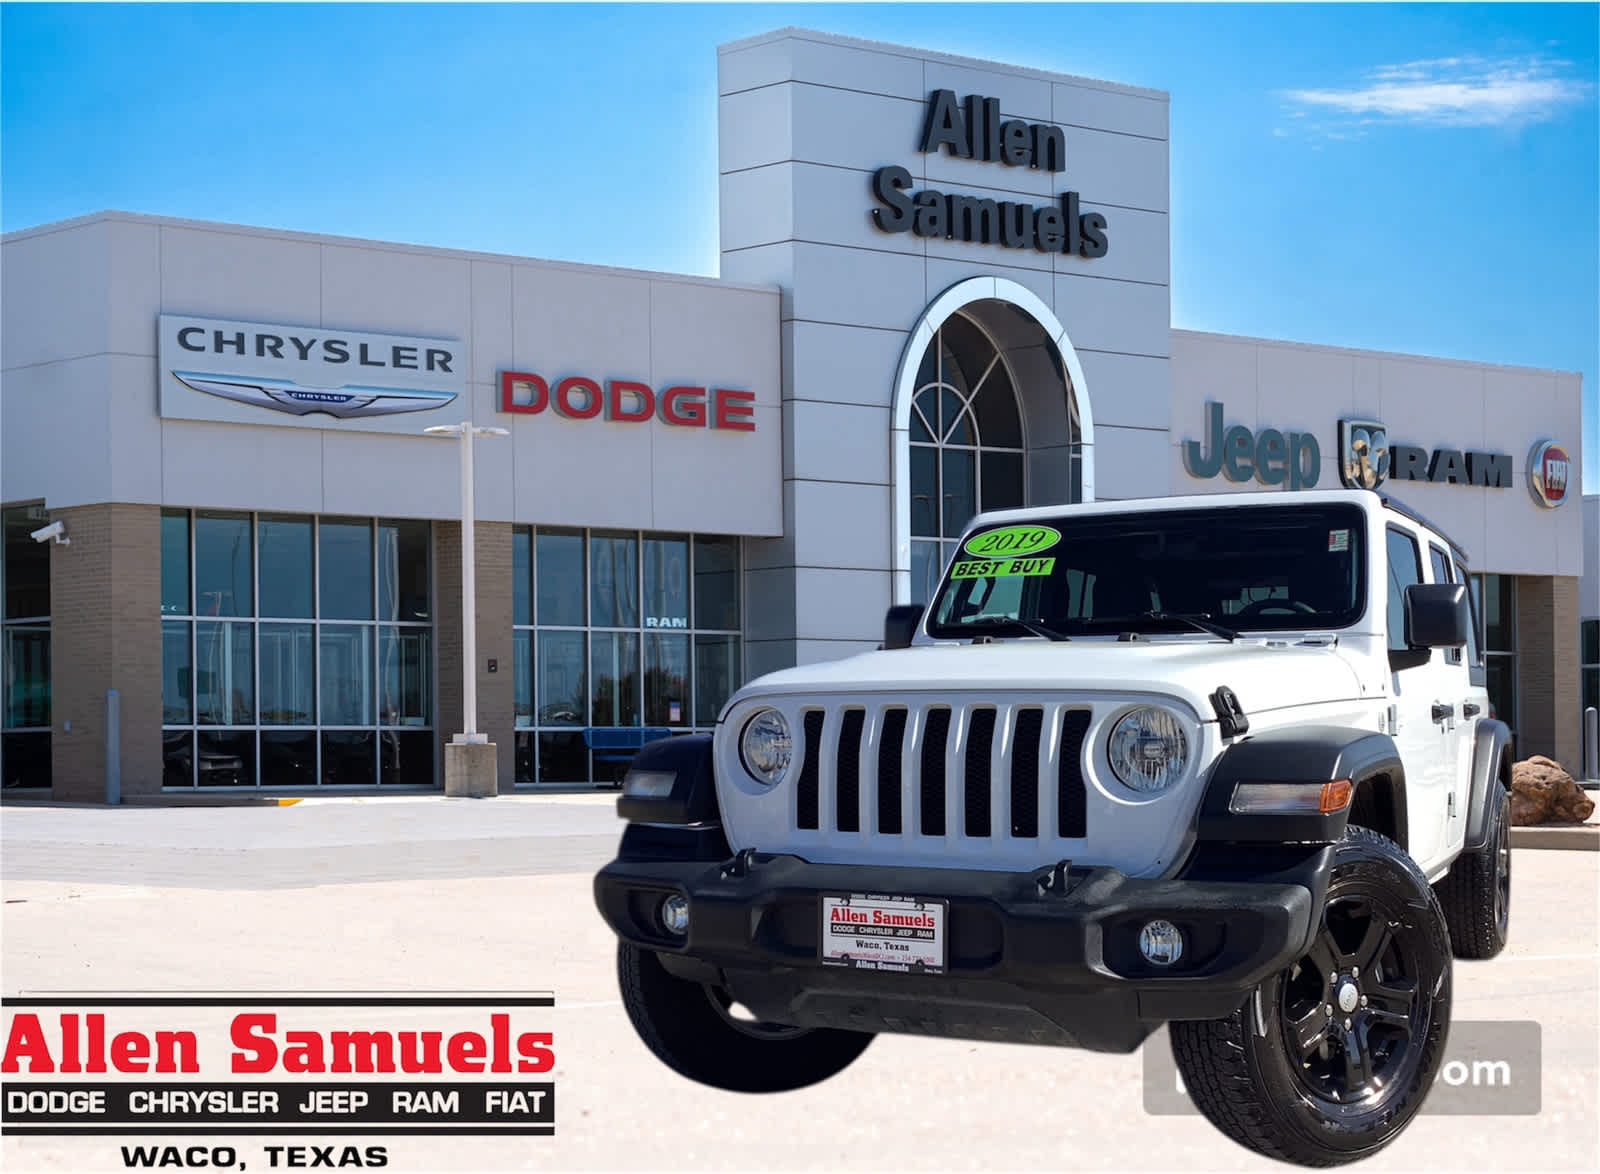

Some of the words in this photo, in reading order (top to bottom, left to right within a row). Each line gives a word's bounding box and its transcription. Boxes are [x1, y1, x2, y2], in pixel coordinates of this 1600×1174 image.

[919, 88, 1066, 172] Allen
[872, 165, 1109, 258] Samuels
[177, 327, 454, 373] CHRYSLER
[291, 392, 347, 401] CHRYSLER
[496, 370, 756, 432] DODGE
[1182, 401, 1321, 491] Jeep
[1388, 444, 1513, 488] RAM
[1545, 459, 1568, 489] FIAT
[978, 531, 1047, 553] 2019
[955, 561, 1005, 577] BEST
[1009, 559, 1050, 575] BUY
[646, 616, 688, 628] RAM
[830, 907, 868, 923] Allen
[873, 910, 935, 928] Samuels
[833, 925, 855, 933] DODGE
[859, 926, 893, 936] CHRYSLER
[896, 929, 913, 937] JEEP
[917, 930, 934, 938] RAM
[855, 940, 882, 950] Waco,
[885, 942, 910, 952] Texas
